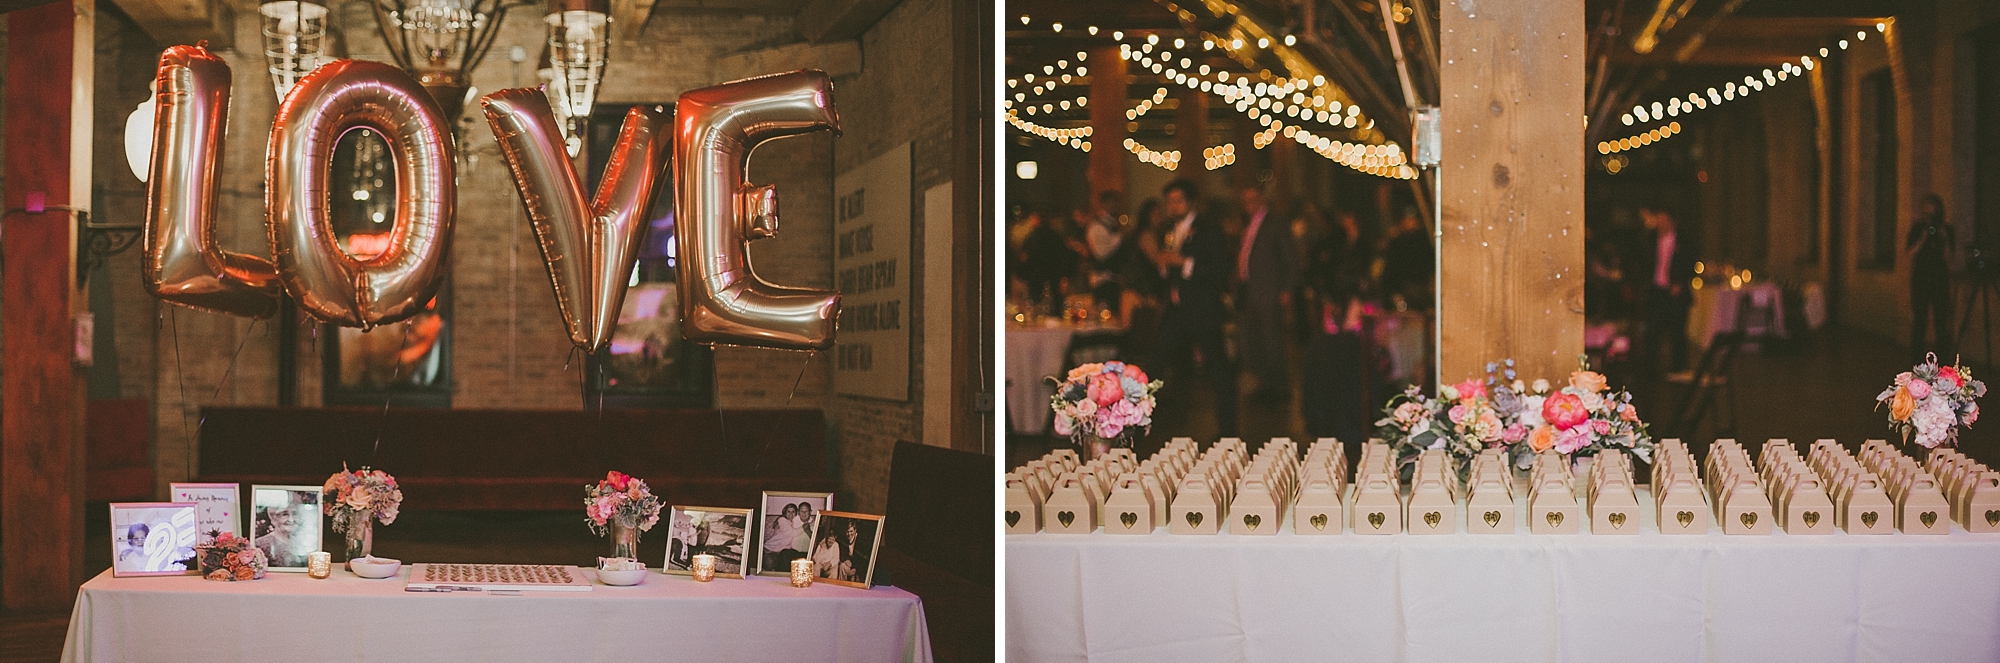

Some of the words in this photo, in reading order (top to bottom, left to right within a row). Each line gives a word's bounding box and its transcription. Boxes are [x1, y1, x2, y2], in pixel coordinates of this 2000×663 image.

[142, 41, 843, 355] LOVE
[875, 257, 897, 291] SPRAY
[879, 299, 901, 331] ALONE
